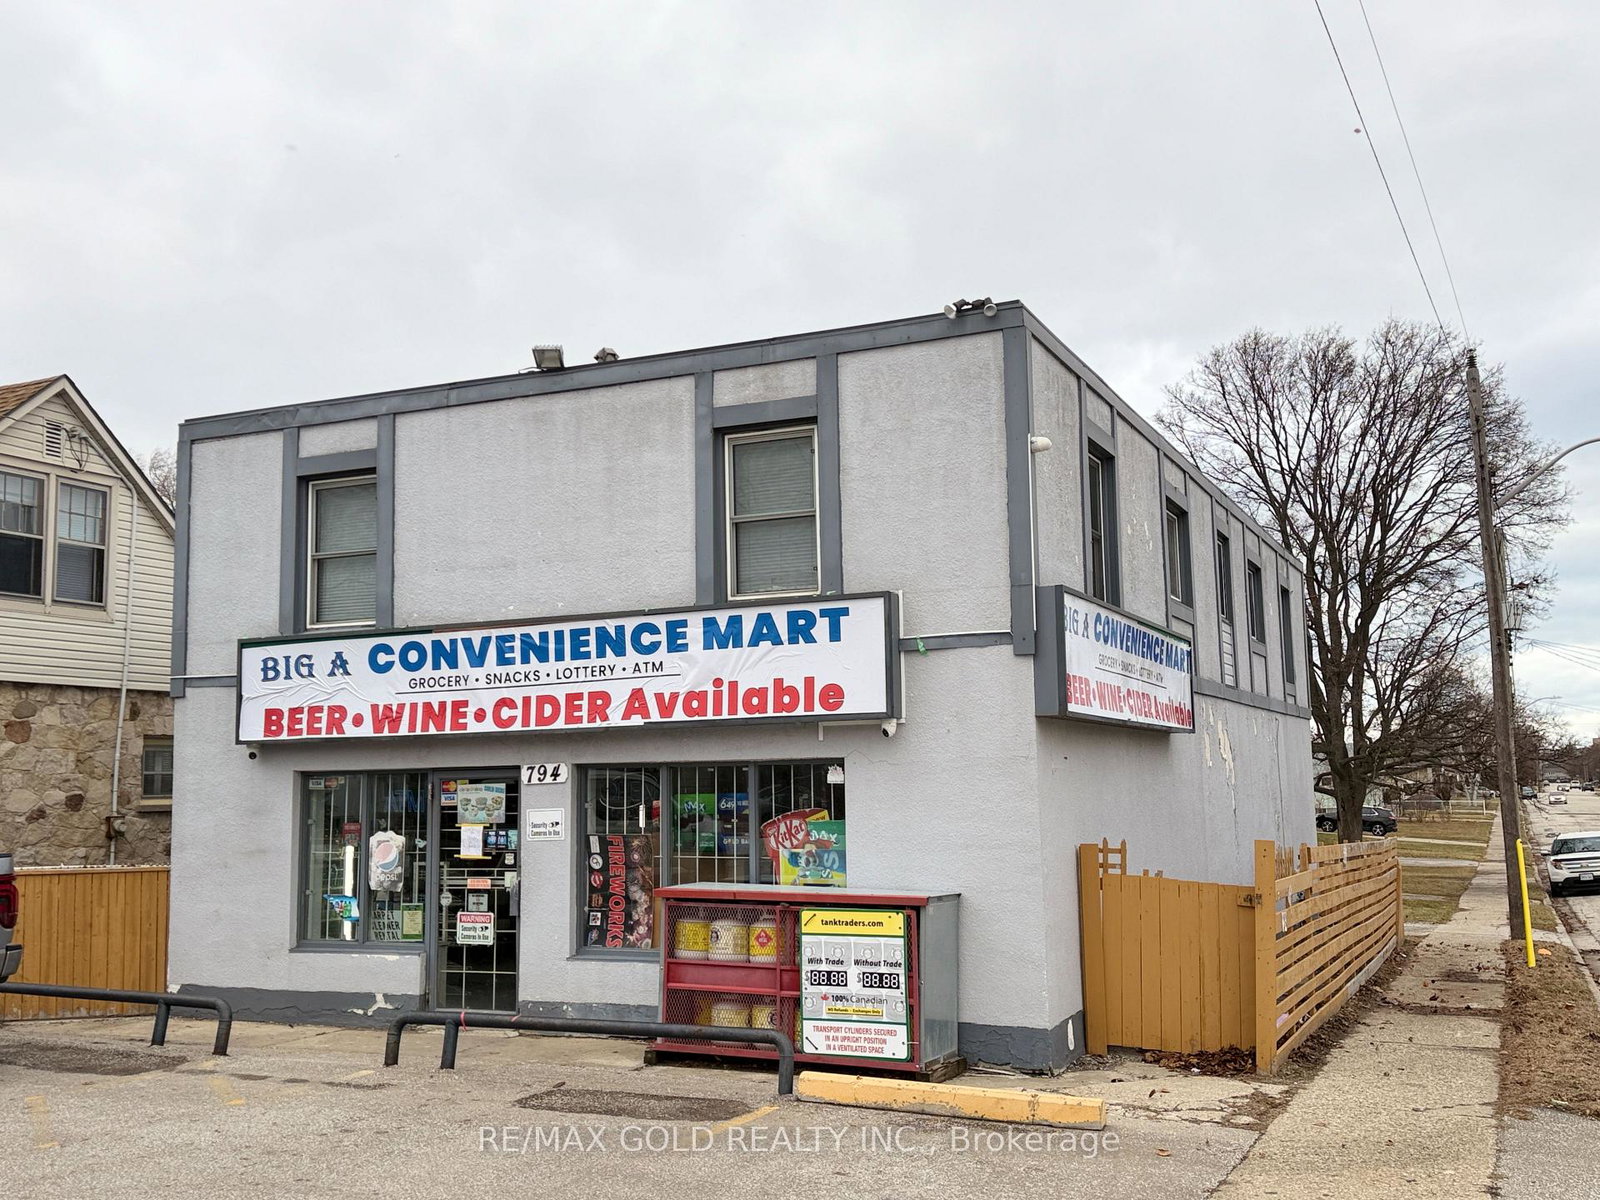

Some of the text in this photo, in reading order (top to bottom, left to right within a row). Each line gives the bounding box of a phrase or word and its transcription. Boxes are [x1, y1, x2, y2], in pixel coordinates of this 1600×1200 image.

[261, 606, 849, 682] BIG A CONVENIENCE MART
[1082, 613, 1089, 639] A
[1094, 612, 1164, 665] CONVENIENCE
[1165, 642, 1191, 674] MART
[1099, 654, 1118, 669] GROCERY
[408, 660, 664, 689] GROCERY SNACKS LOTTERY ATM
[263, 676, 845, 738] BEER WINE CIDER Available
[1066, 673, 1192, 727] BEER WINE CIDER Available
[526, 764, 561, 783] 794
[531, 821, 547, 829] Security
[770, 819, 805, 849] KitKat
[606, 835, 626, 949] FIREWORKS
[461, 915, 490, 923] WARNING
[821, 918, 884, 928] tanktraders.com
[461, 925, 477, 933] Security
[808, 957, 844, 966] With Trade
[854, 959, 902, 968] Without Trade
[811, 971, 847, 986] 88.88
[863, 973, 899, 988] 88.88
[850, 995, 888, 1005] Canadian
[813, 1025, 897, 1037] TRANSPORT CYLINDERS SECURED
[825, 1034, 830, 1042] IN
[840, 1036, 862, 1044] UPRIGHT
[863, 1037, 887, 1045] POSITION
[837, 1044, 867, 1053] VENTILATED
[868, 1046, 885, 1054] SPACE
